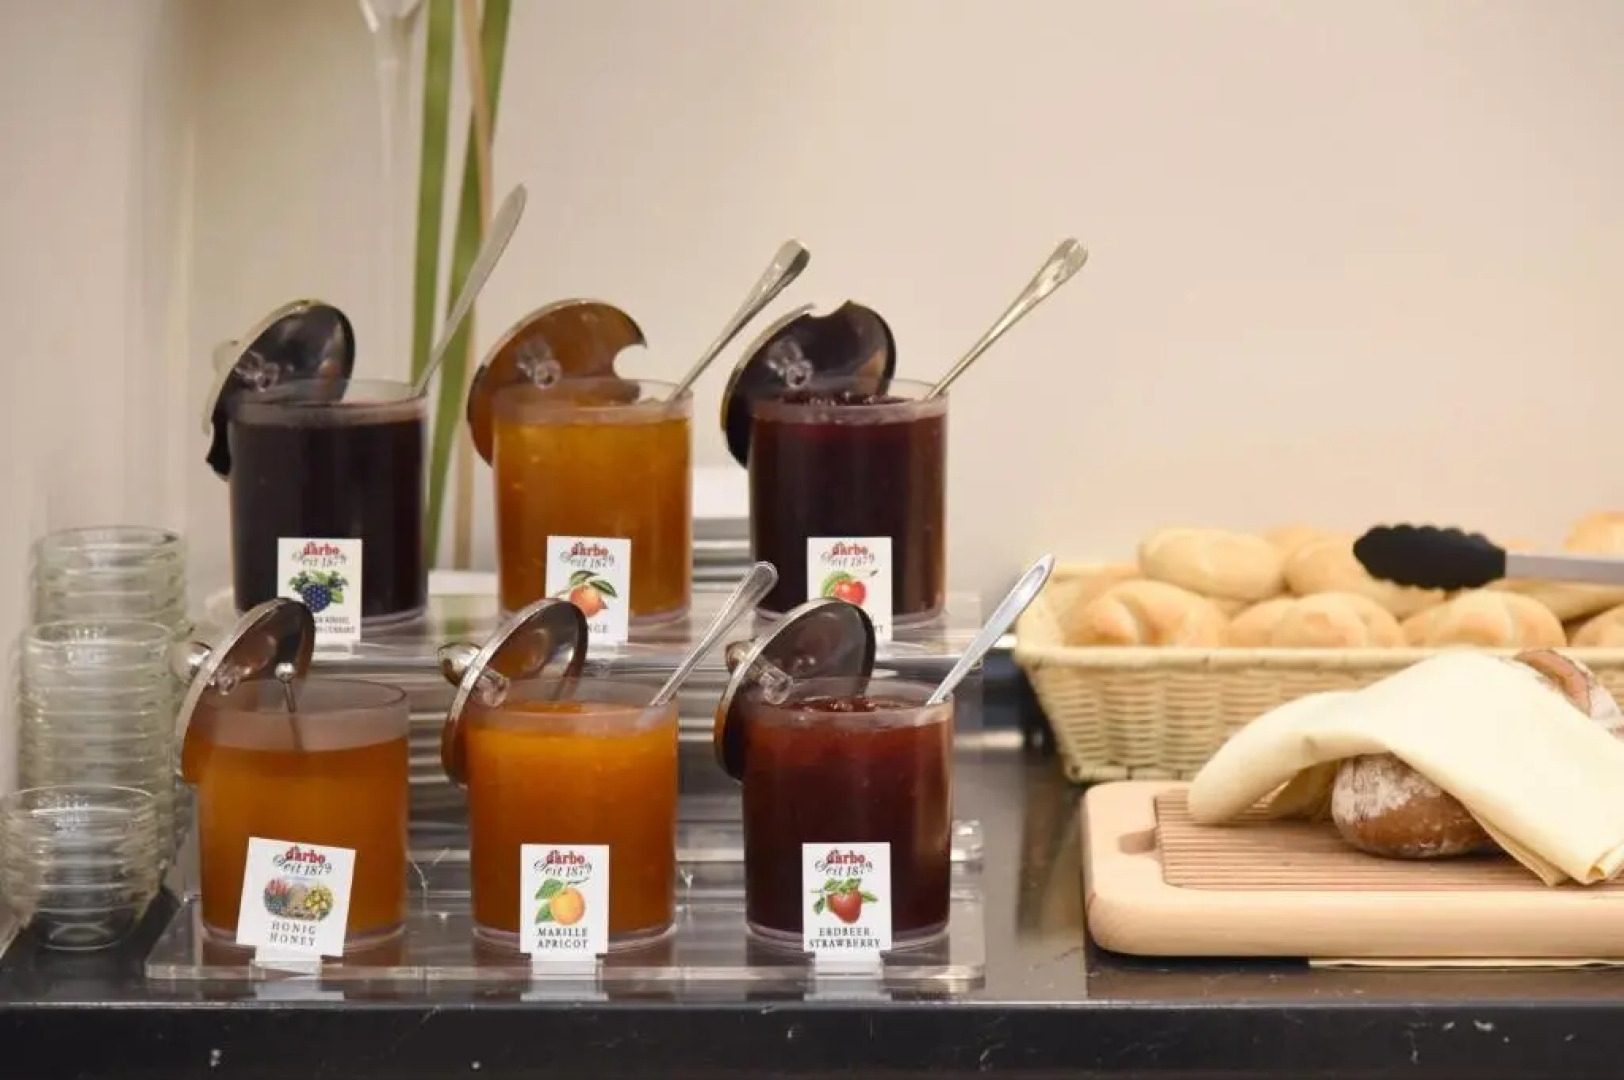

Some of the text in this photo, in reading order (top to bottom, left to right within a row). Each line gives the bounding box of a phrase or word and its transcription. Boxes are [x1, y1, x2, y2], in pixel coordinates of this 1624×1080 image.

[304, 862, 332, 875] 1879
[272, 921, 316, 935] HONIG
[538, 927, 588, 937] MARILLE
[819, 927, 870, 937] ERDBEER
[269, 932, 316, 946] HONEY
[538, 939, 588, 949] APRICOT
[809, 938, 881, 949] STRAWBERRY
